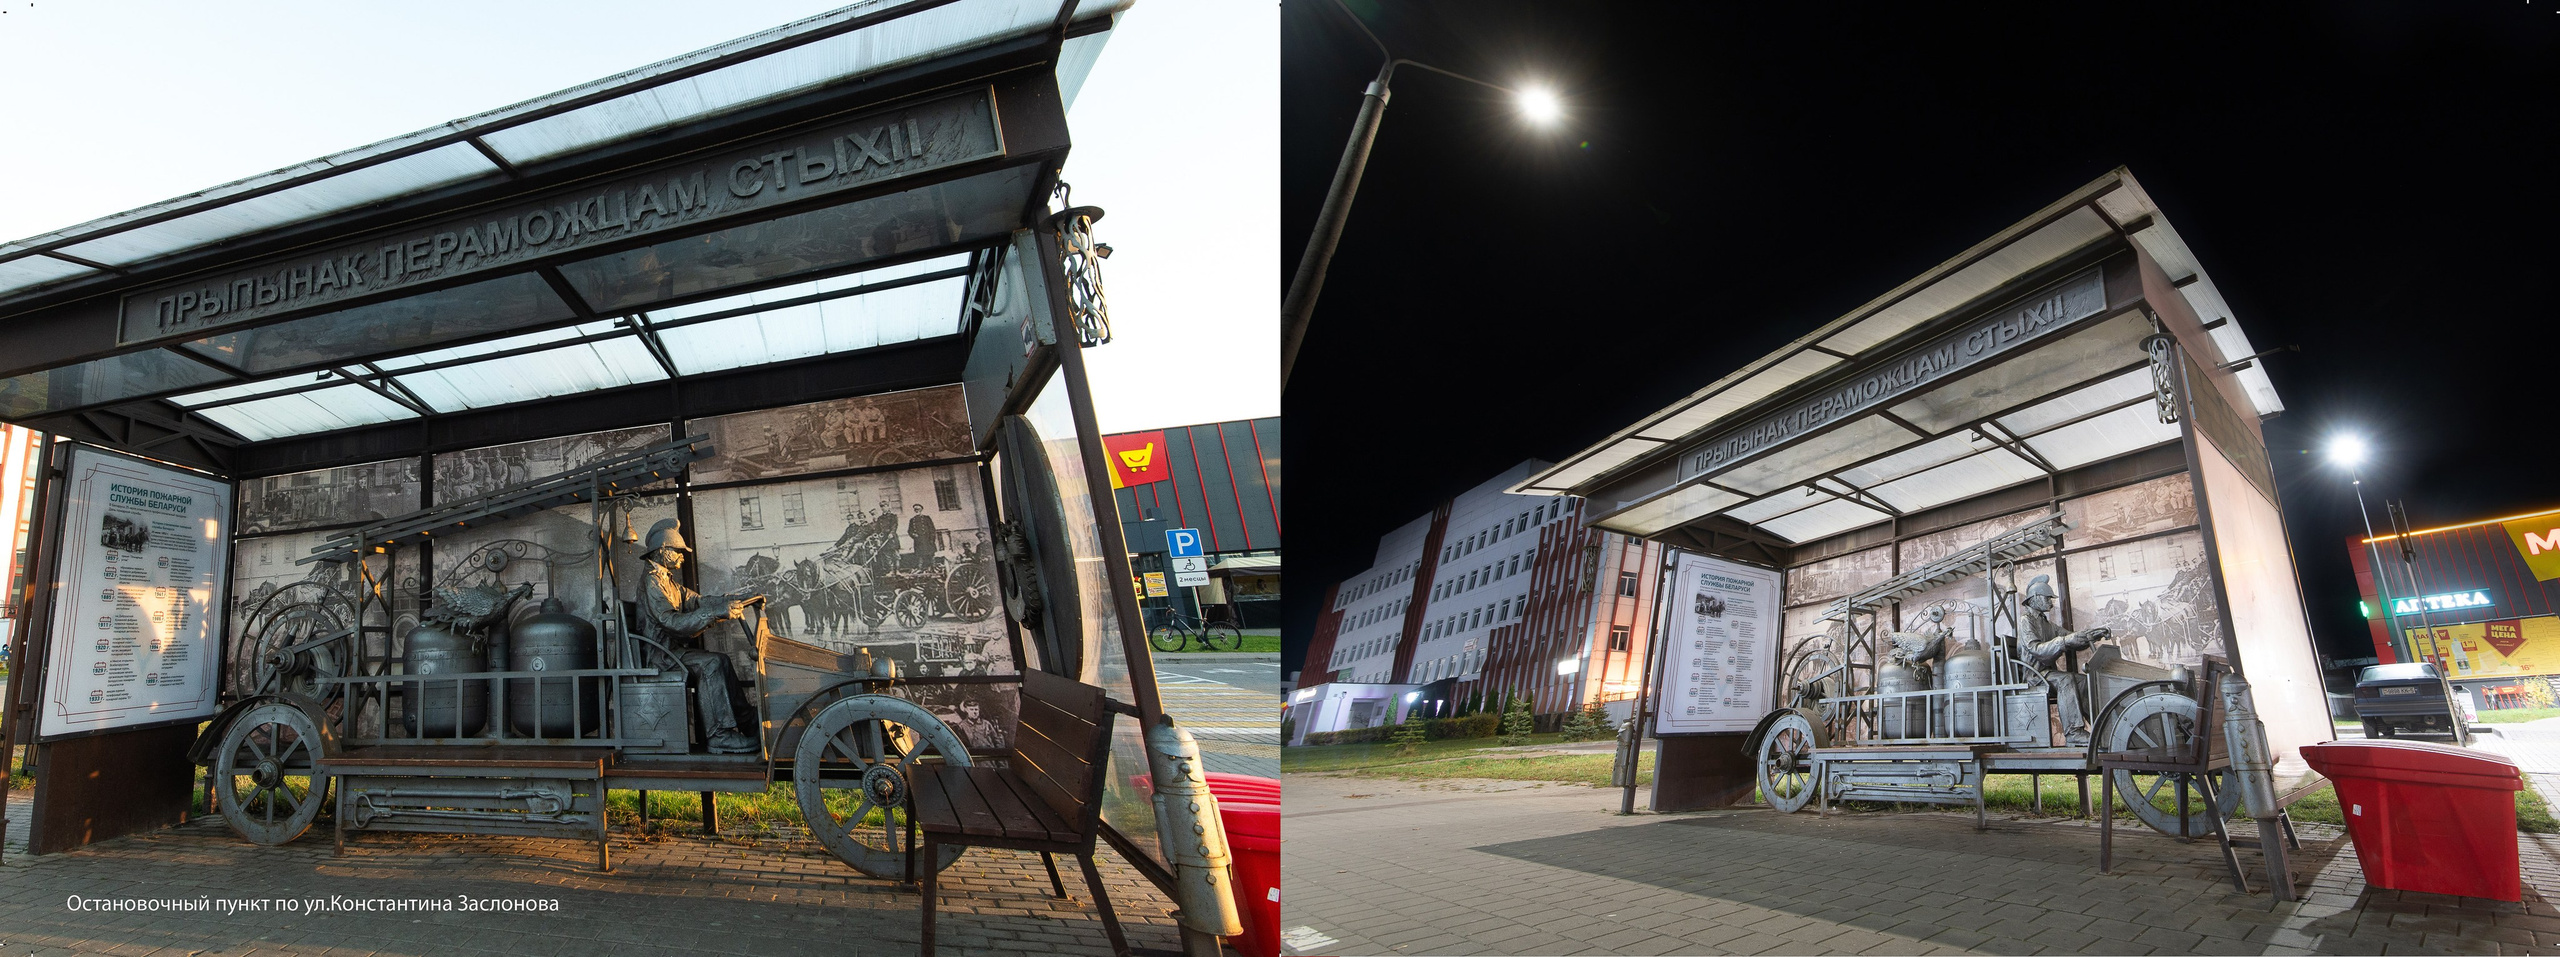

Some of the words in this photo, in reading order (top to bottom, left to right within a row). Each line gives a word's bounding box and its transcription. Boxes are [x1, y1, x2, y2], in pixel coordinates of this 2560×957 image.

[155, 252, 364, 327] ПРЫПЫНАК
[379, 170, 707, 279] ПЕРАМОЖЦАМ
[1694, 415, 1791, 472] ПРЫПЫНАК
[1795, 343, 1956, 430] ПЕРАМОЖЦАМ
[109, 493, 147, 507] СЛУЖБЫ
[148, 500, 187, 513] БЕЛАРУСИ
[110, 483, 149, 497] ИСТОРИЯ
[150, 490, 192, 505] ПОЖАРНОЙ
[1175, 532, 1194, 554] P
[1700, 580, 1724, 588] СЛУЖБЫ
[1725, 583, 1751, 592] БЕЛАРУСИ
[1701, 573, 1726, 582] ИСТОРИЯ
[1726, 577, 1755, 587] ПОЖАРНОЙ
[2396, 591, 2490, 613] АПТЕКА
[2491, 624, 2516, 632] МЕГА
[2491, 631, 2517, 639] ЦЕНА
